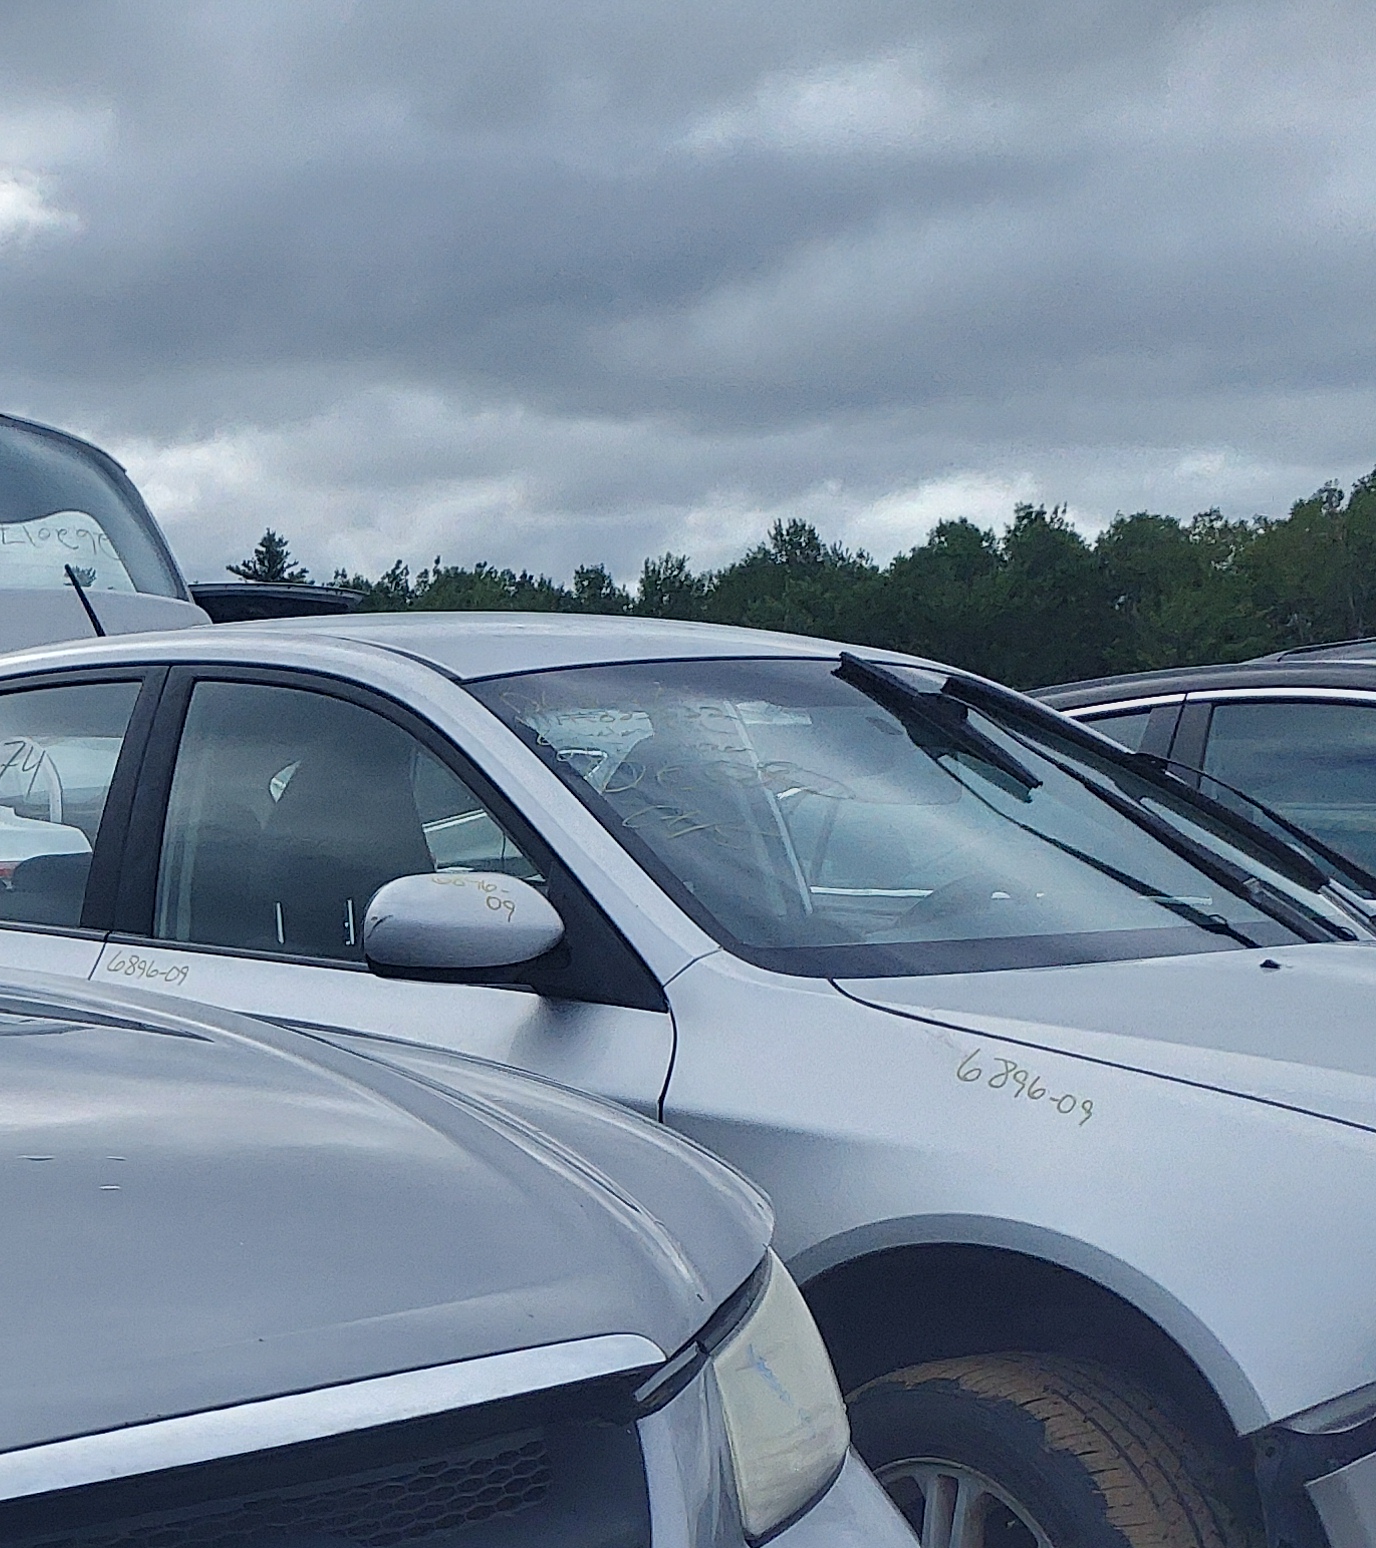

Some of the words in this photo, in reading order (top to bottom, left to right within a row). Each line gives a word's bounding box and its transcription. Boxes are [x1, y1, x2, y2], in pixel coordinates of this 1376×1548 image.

[486, 896, 515, 922] 09
[106, 950, 190, 985] 6896-09
[956, 1048, 1094, 1126] 6896-09
